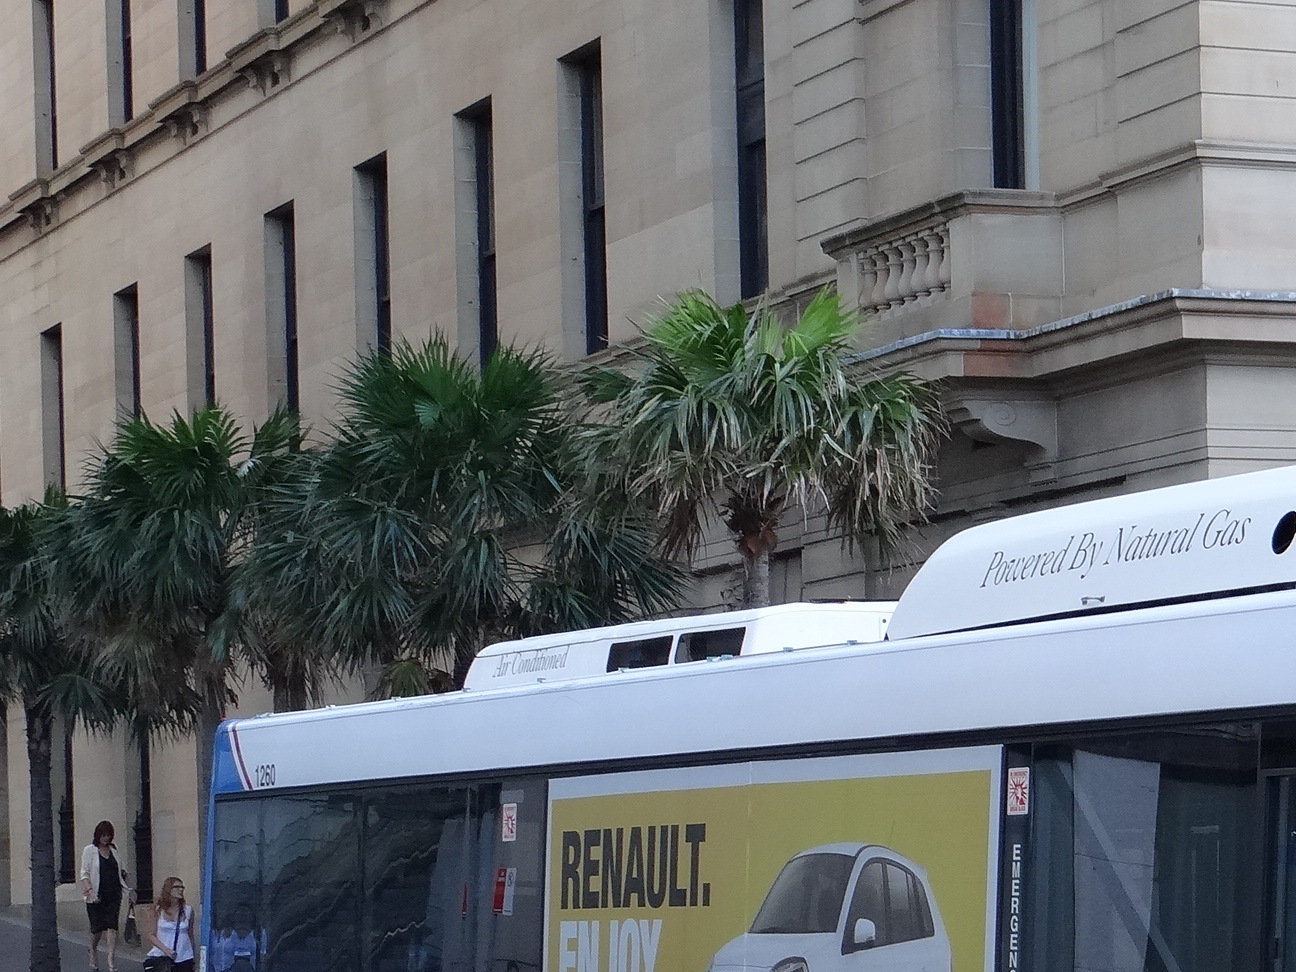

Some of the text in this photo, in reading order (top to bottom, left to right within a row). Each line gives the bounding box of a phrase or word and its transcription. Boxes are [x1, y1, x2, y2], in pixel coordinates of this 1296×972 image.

[980, 509, 1252, 588] Powered By Natural Gas
[492, 645, 570, 678] Air Conditioned
[255, 764, 276, 787] 1260
[560, 823, 711, 909] RENAULT.
